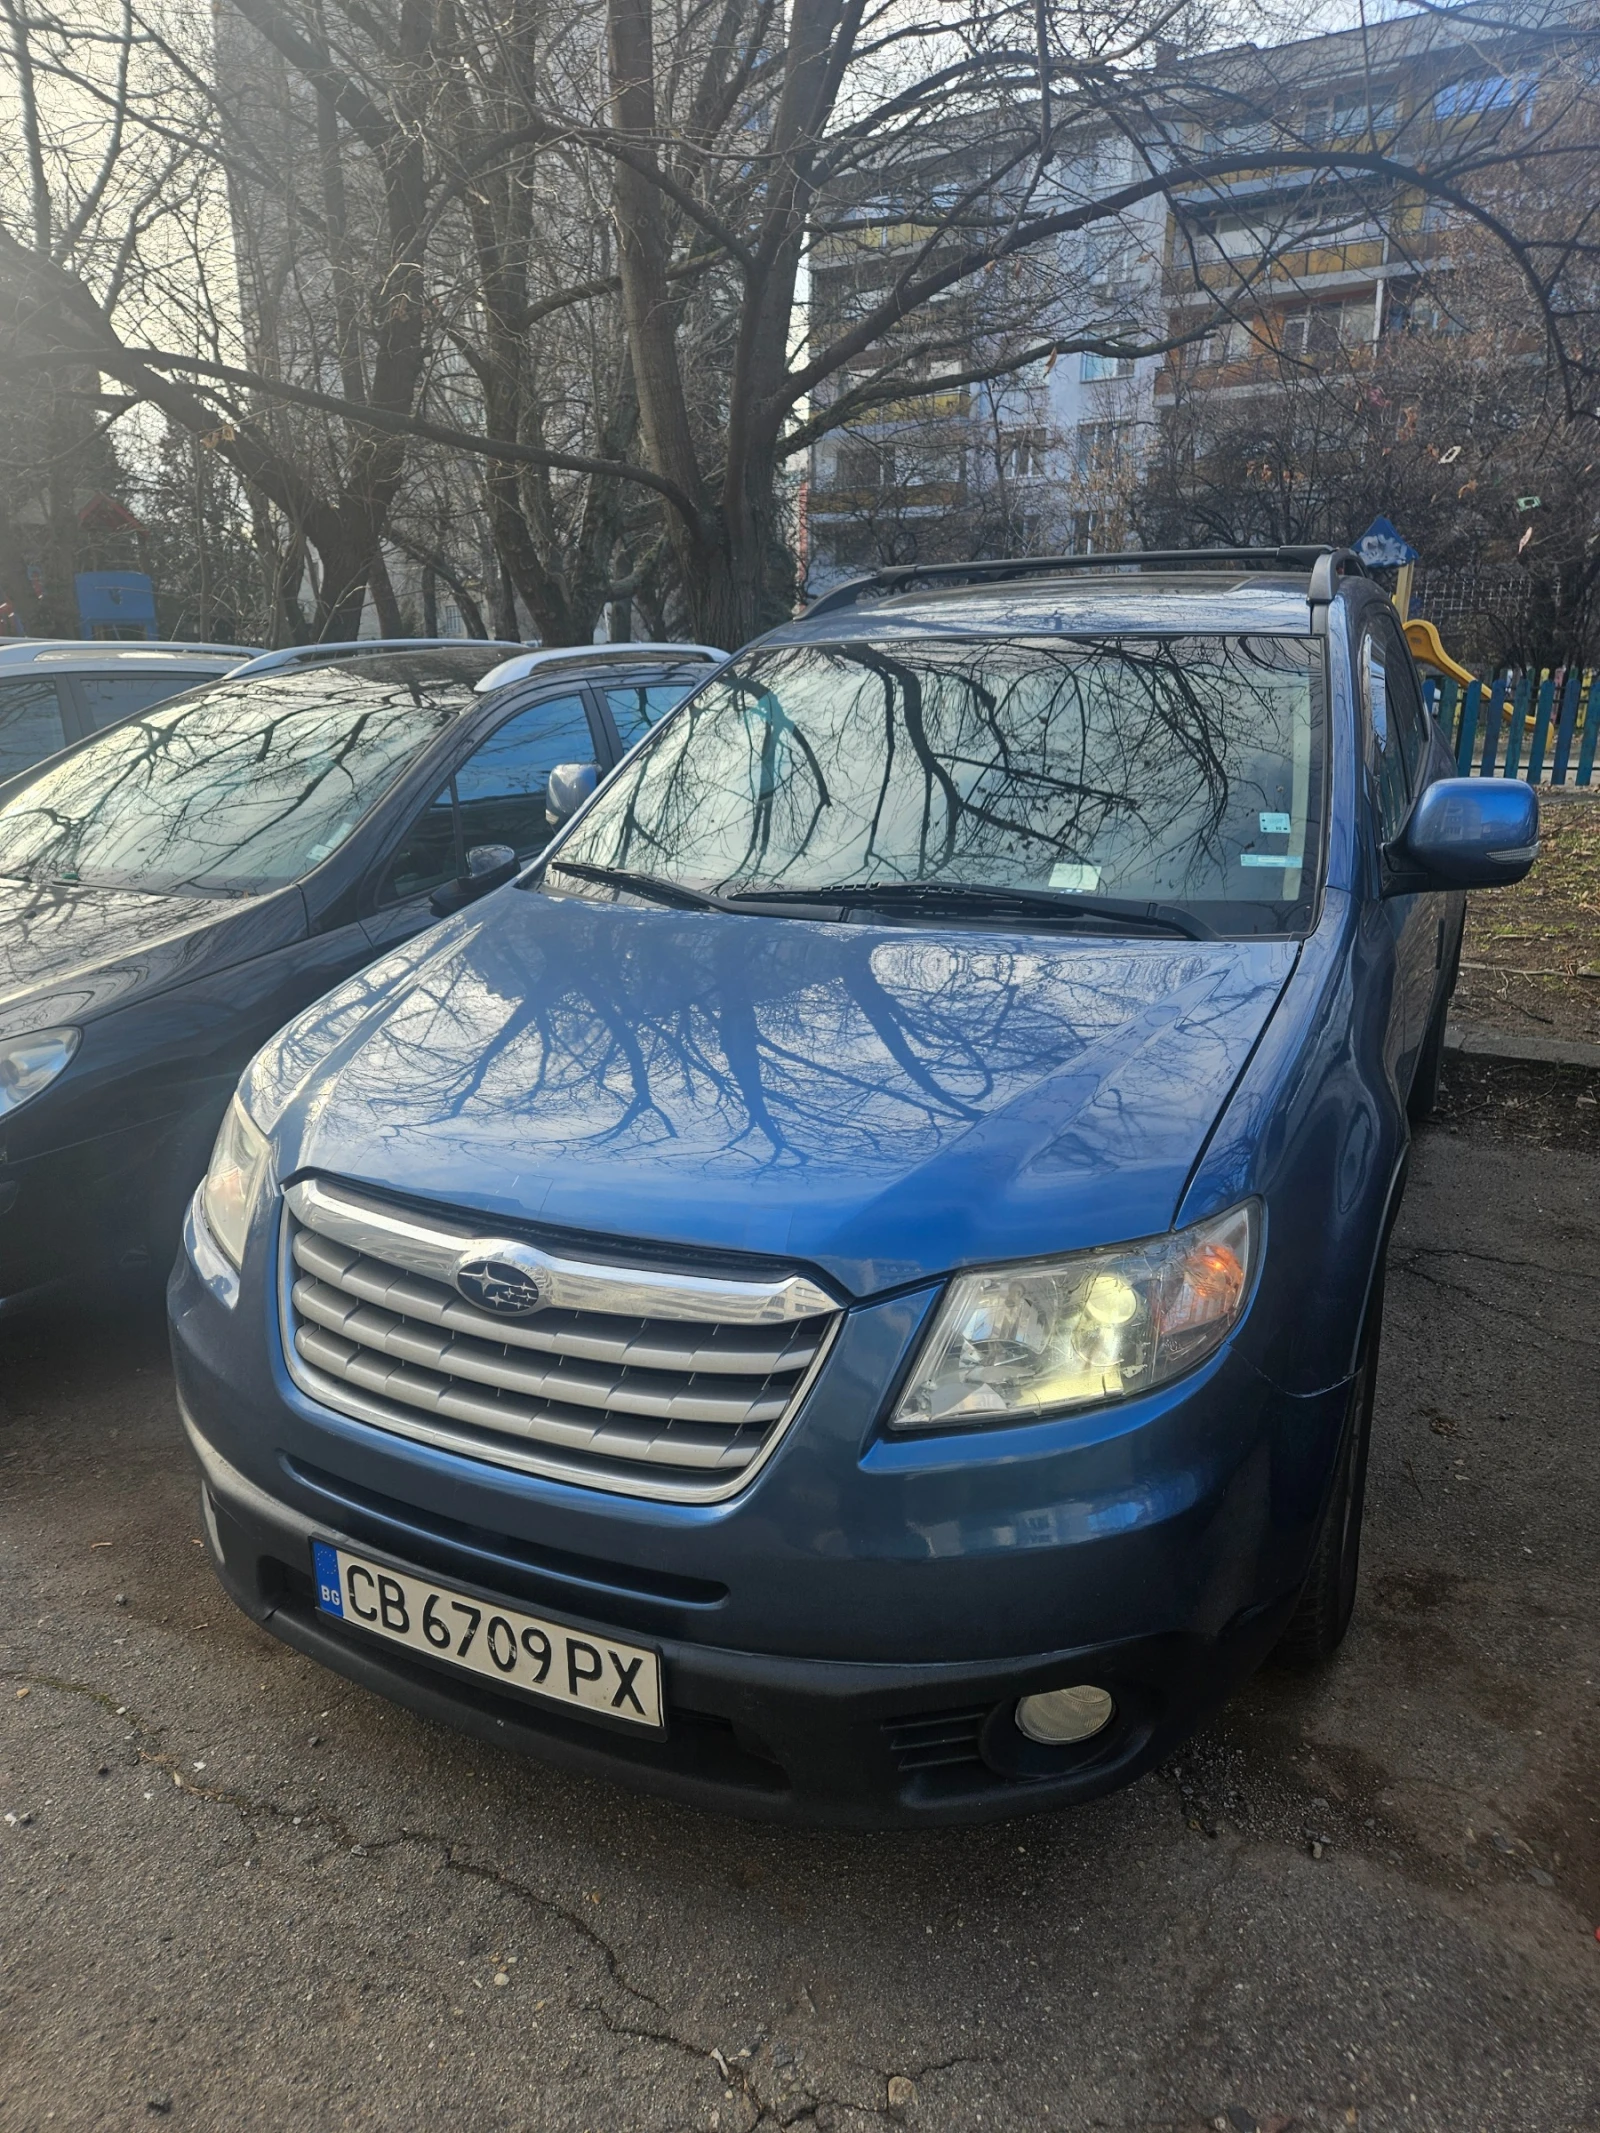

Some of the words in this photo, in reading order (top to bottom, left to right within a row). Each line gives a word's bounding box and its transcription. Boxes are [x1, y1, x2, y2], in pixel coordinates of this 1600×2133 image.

[321, 1585, 340, 1606] BG
[346, 1564, 410, 1634] CB
[422, 1594, 551, 1684] 6709
[566, 1637, 647, 1716] PX
